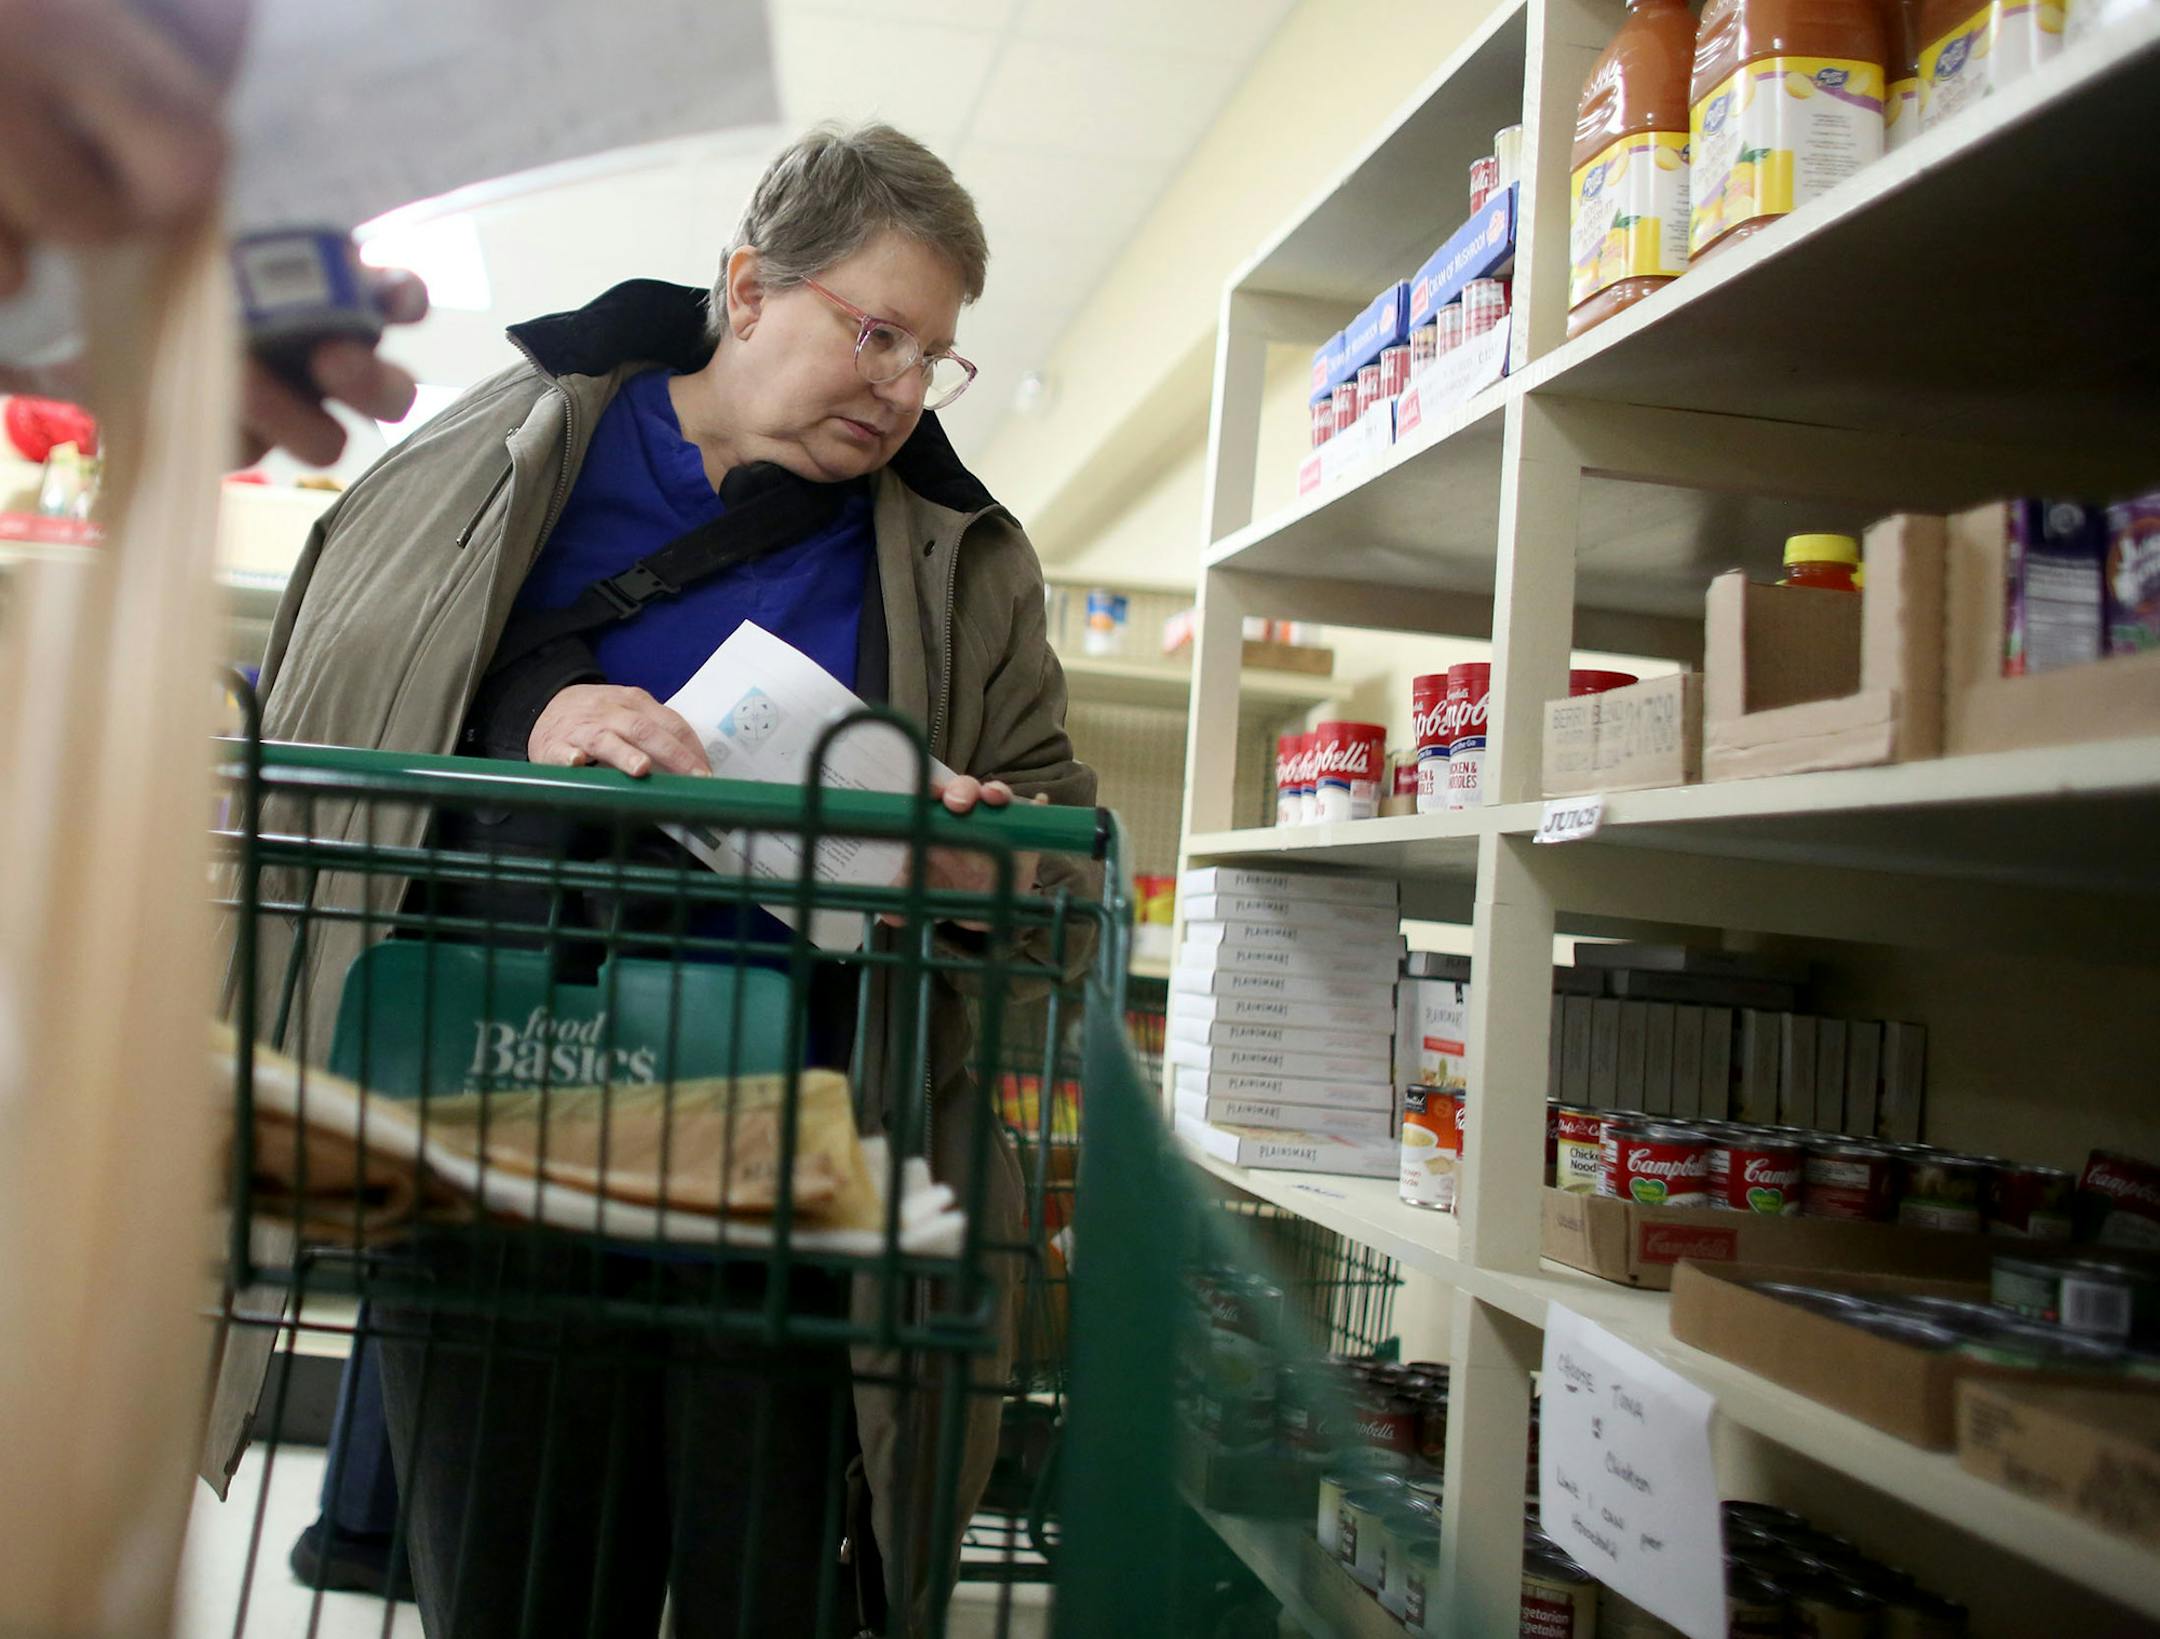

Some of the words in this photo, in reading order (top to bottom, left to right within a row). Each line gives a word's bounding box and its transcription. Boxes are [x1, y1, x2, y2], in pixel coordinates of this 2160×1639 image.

[1543, 805, 1600, 834] JUICE
[1569, 1146, 1600, 1161] Chicke
[1570, 1159, 1598, 1173] Nood
